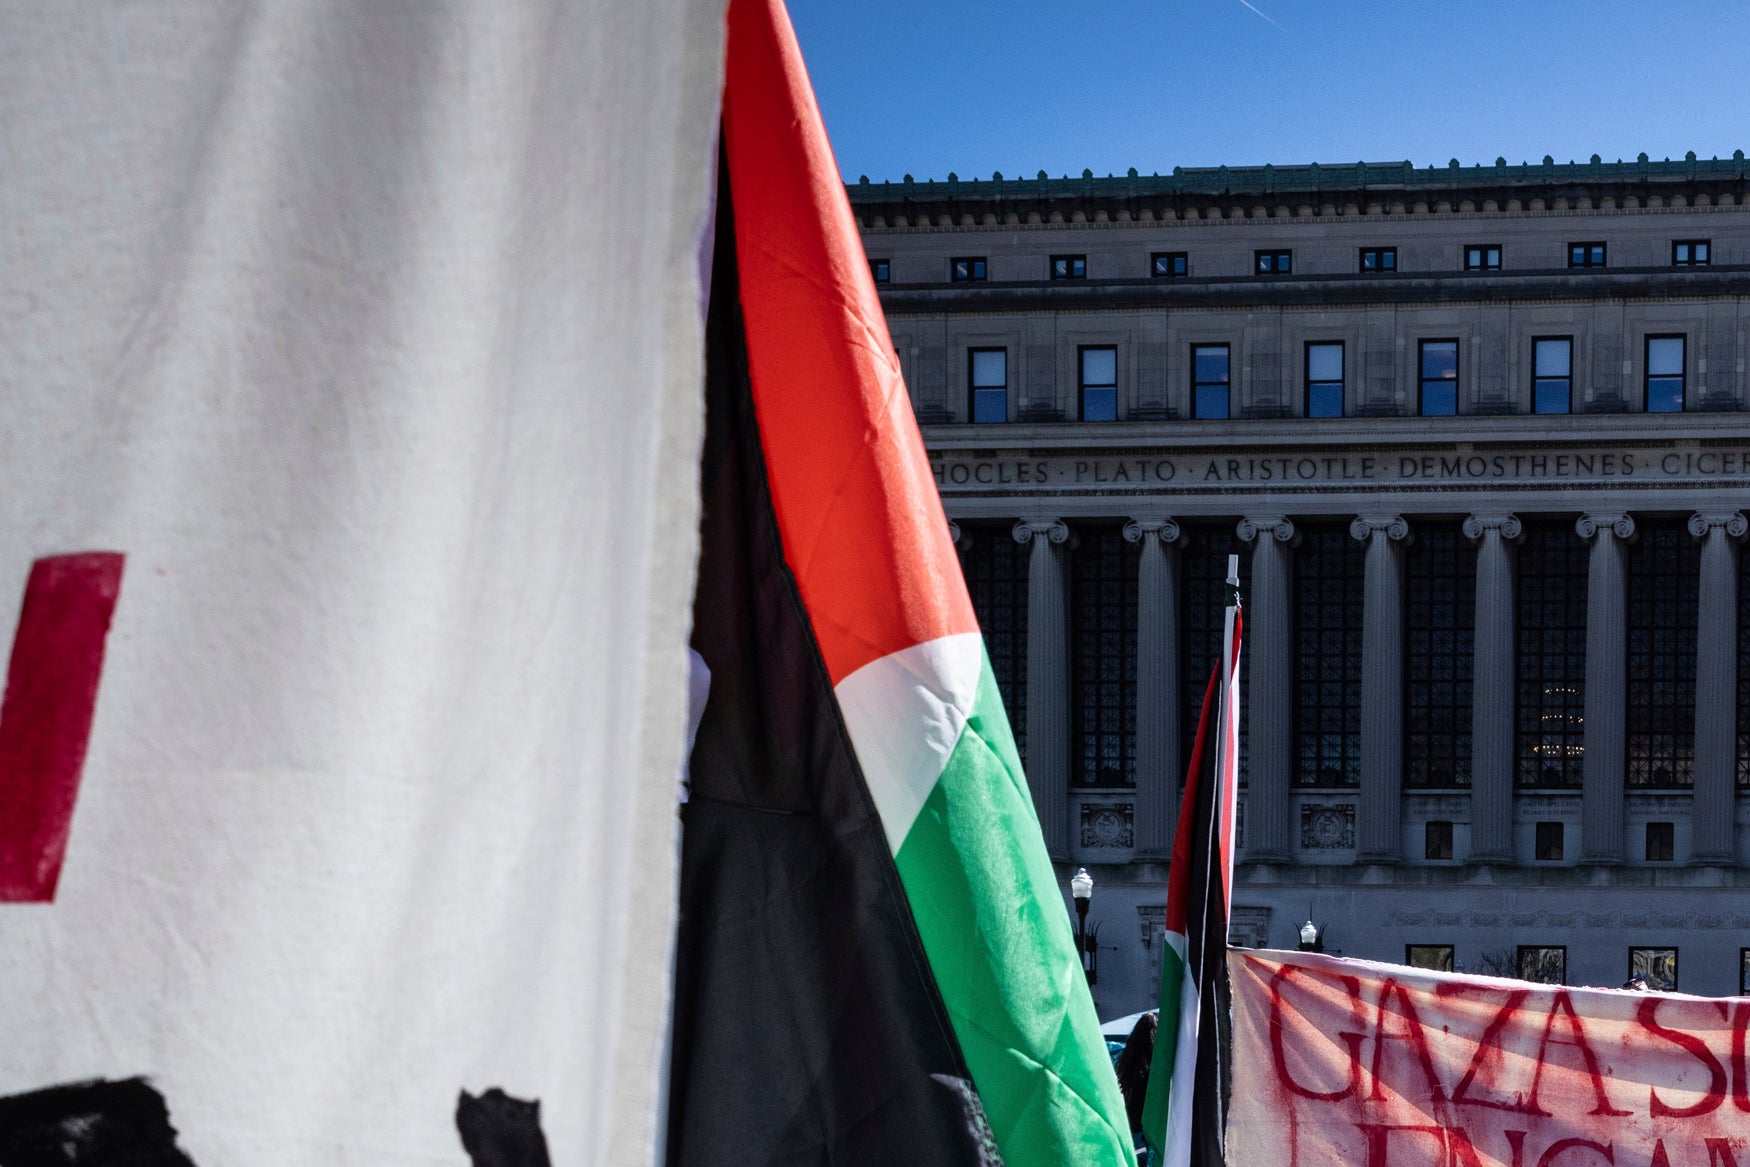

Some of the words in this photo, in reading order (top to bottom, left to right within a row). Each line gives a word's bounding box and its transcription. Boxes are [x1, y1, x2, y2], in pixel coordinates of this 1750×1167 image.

[1074, 460, 1176, 483] PLATO
[1204, 457, 1375, 481] ARISTOTLE
[1399, 454, 1634, 479] DEMOSTHENES
[1268, 963, 1633, 1117] GAZA
